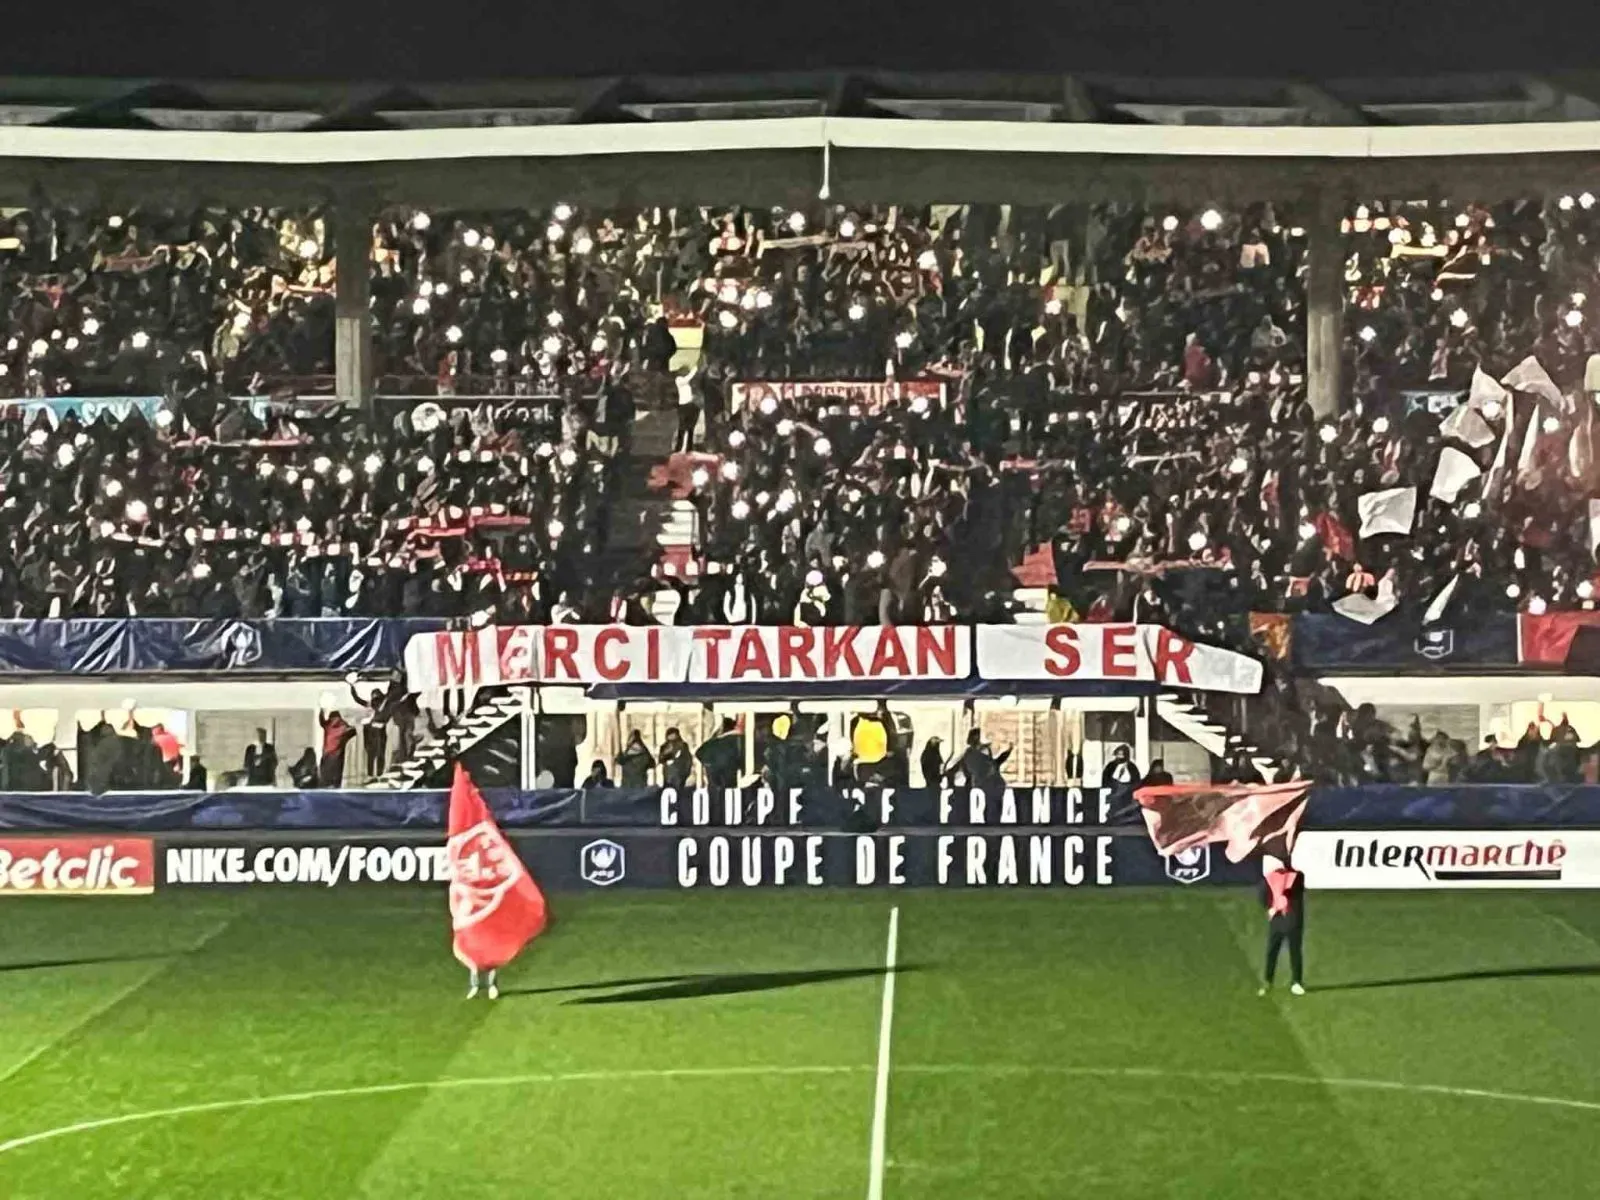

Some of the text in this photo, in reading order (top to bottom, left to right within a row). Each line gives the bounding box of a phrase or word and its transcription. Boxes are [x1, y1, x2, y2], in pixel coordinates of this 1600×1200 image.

[694, 625, 956, 679] TARKAN
[1044, 625, 1194, 683] SER
[660, 787, 803, 826] COUPE
[939, 787, 1112, 824] FRANCE
[677, 835, 1113, 888] COUPE DE FRANCE
